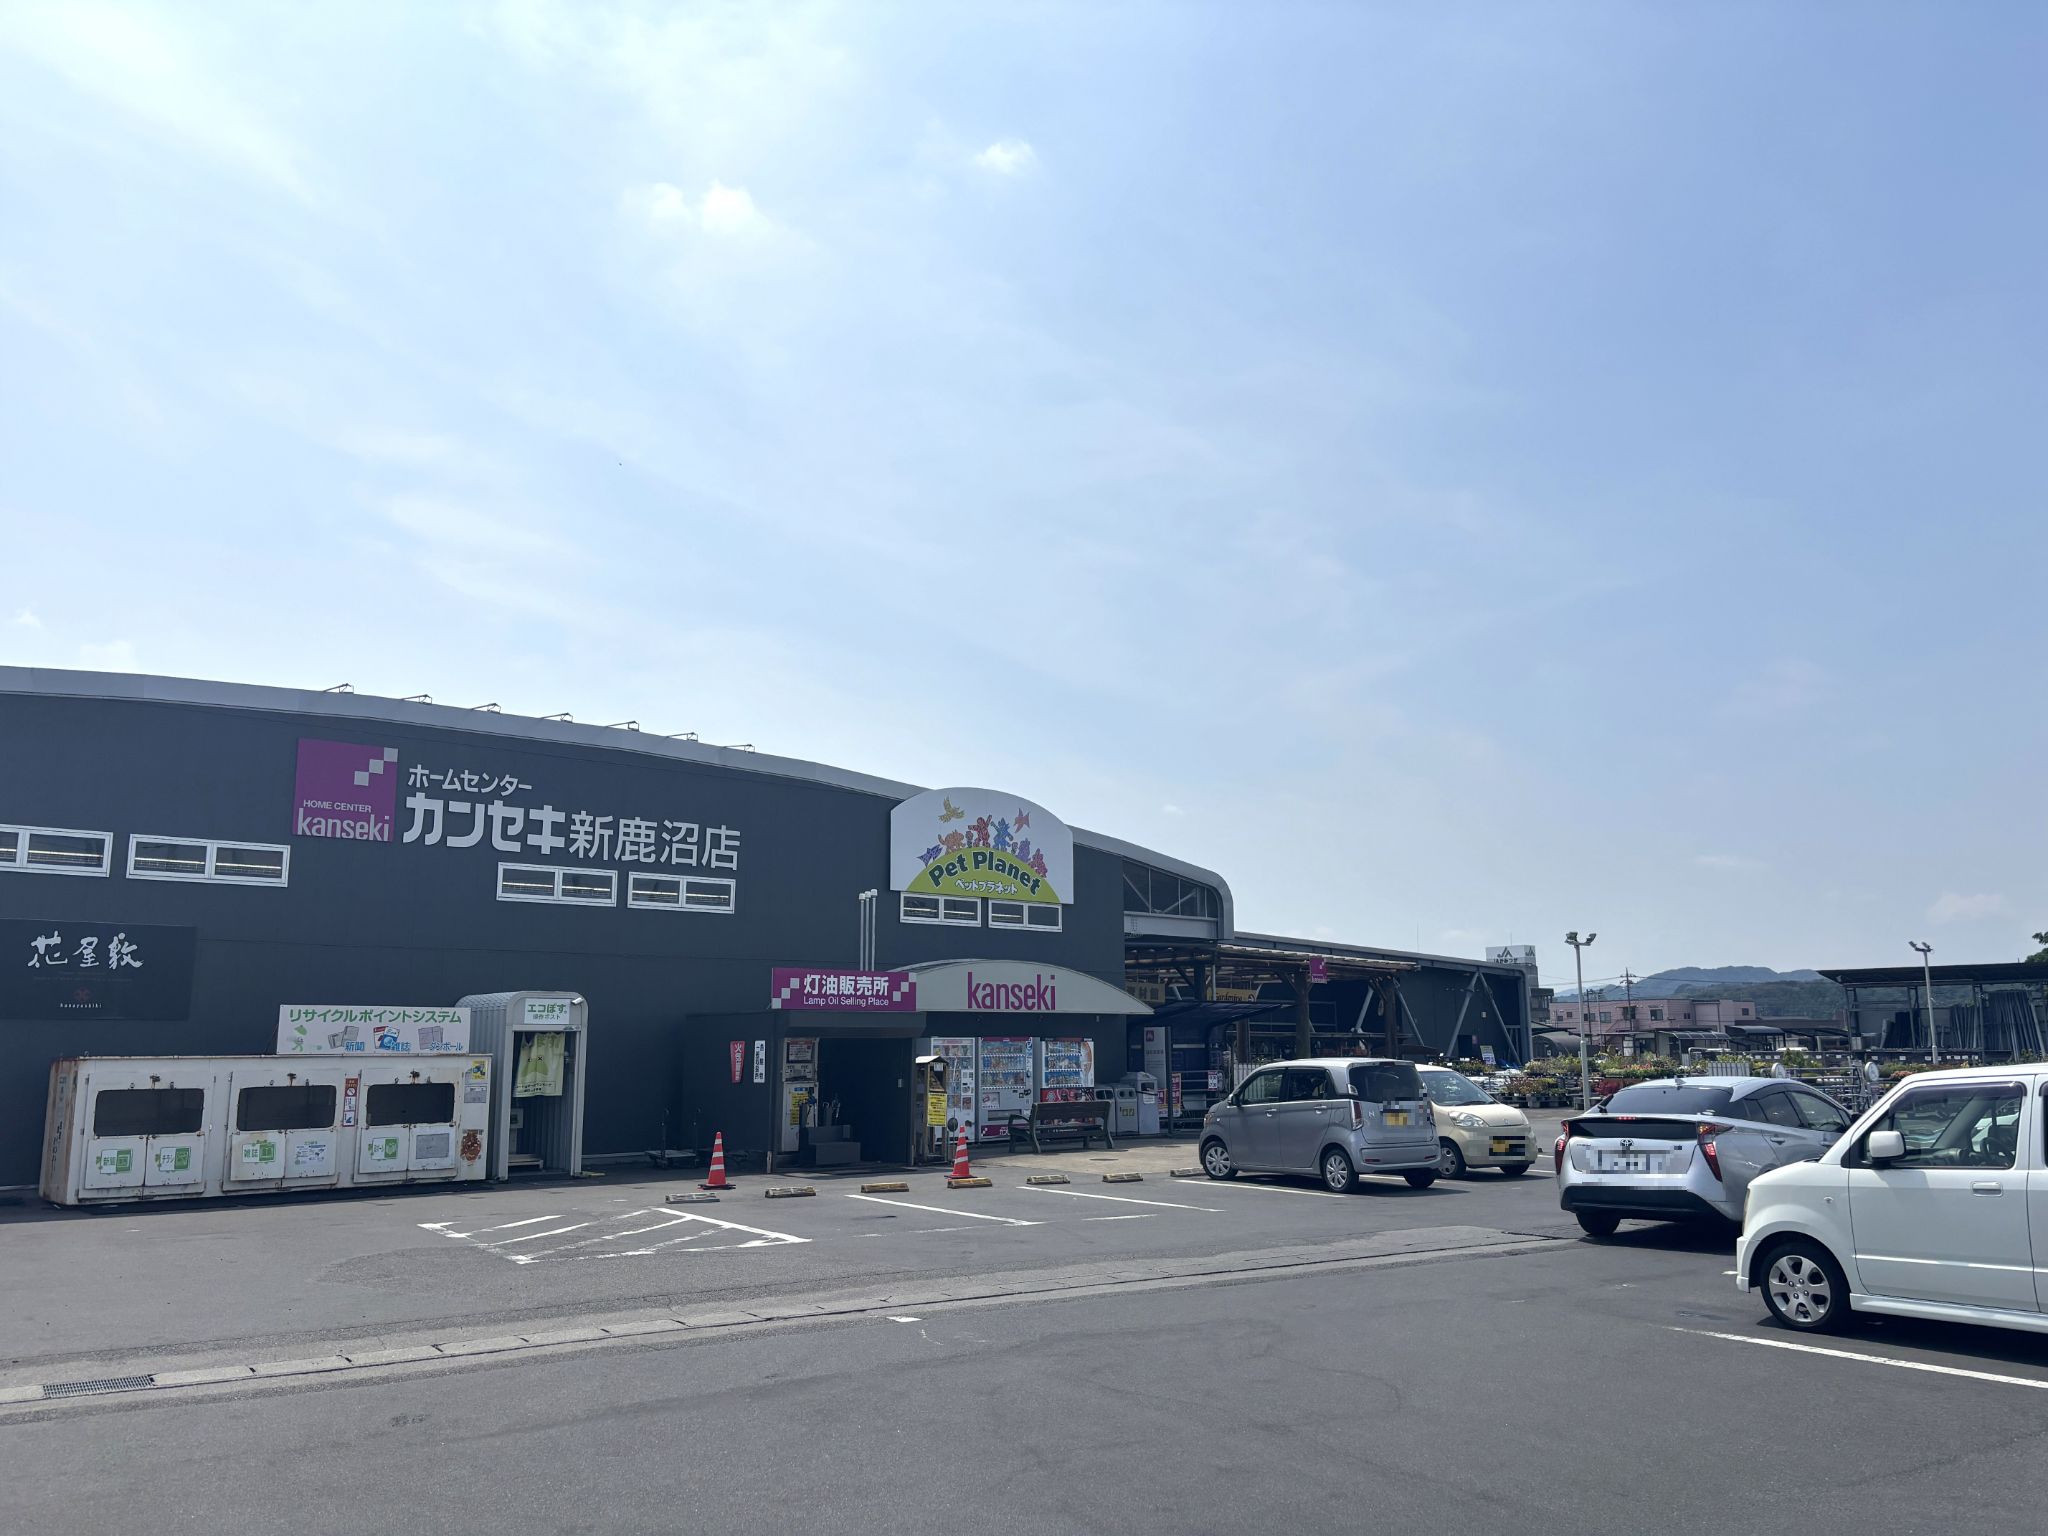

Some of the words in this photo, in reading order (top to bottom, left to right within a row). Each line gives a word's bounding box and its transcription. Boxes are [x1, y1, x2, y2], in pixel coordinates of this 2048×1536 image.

[408, 764, 532, 796] ホームセンター
[303, 799, 333, 810] HOME
[334, 802, 372, 813] CENTER
[297, 808, 390, 841] kanseki
[402, 792, 741, 871] カンセキ新鹿沼店
[928, 853, 968, 887] Pet
[973, 851, 1040, 895] Planet
[955, 879, 1018, 895] ペットプラネット
[803, 974, 889, 996] 灯油販売所
[967, 972, 1056, 1010] kanseki
[803, 996, 826, 1006] Lamp
[828, 996, 839, 1005] Oil
[841, 997, 866, 1007] Selling
[868, 997, 889, 1006] Place
[290, 1008, 462, 1023] リサイクルポイントシステム
